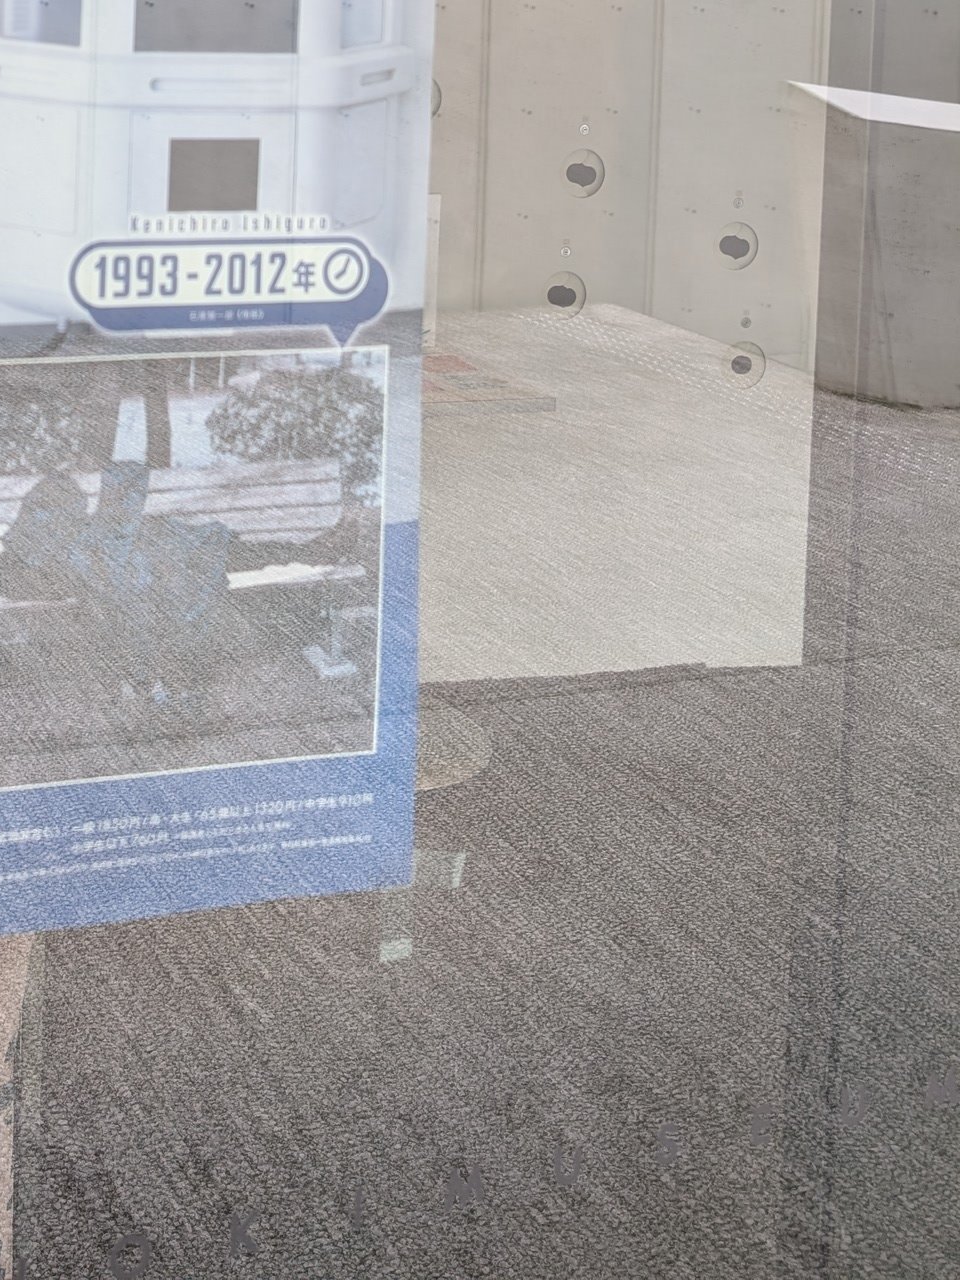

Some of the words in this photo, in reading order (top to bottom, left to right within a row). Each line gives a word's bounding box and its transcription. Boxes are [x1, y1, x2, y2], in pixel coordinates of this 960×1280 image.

[129, 215, 230, 232] Kenichiro
[242, 212, 328, 231] Ishiguro
[94, 252, 316, 298] 1993-2012年
